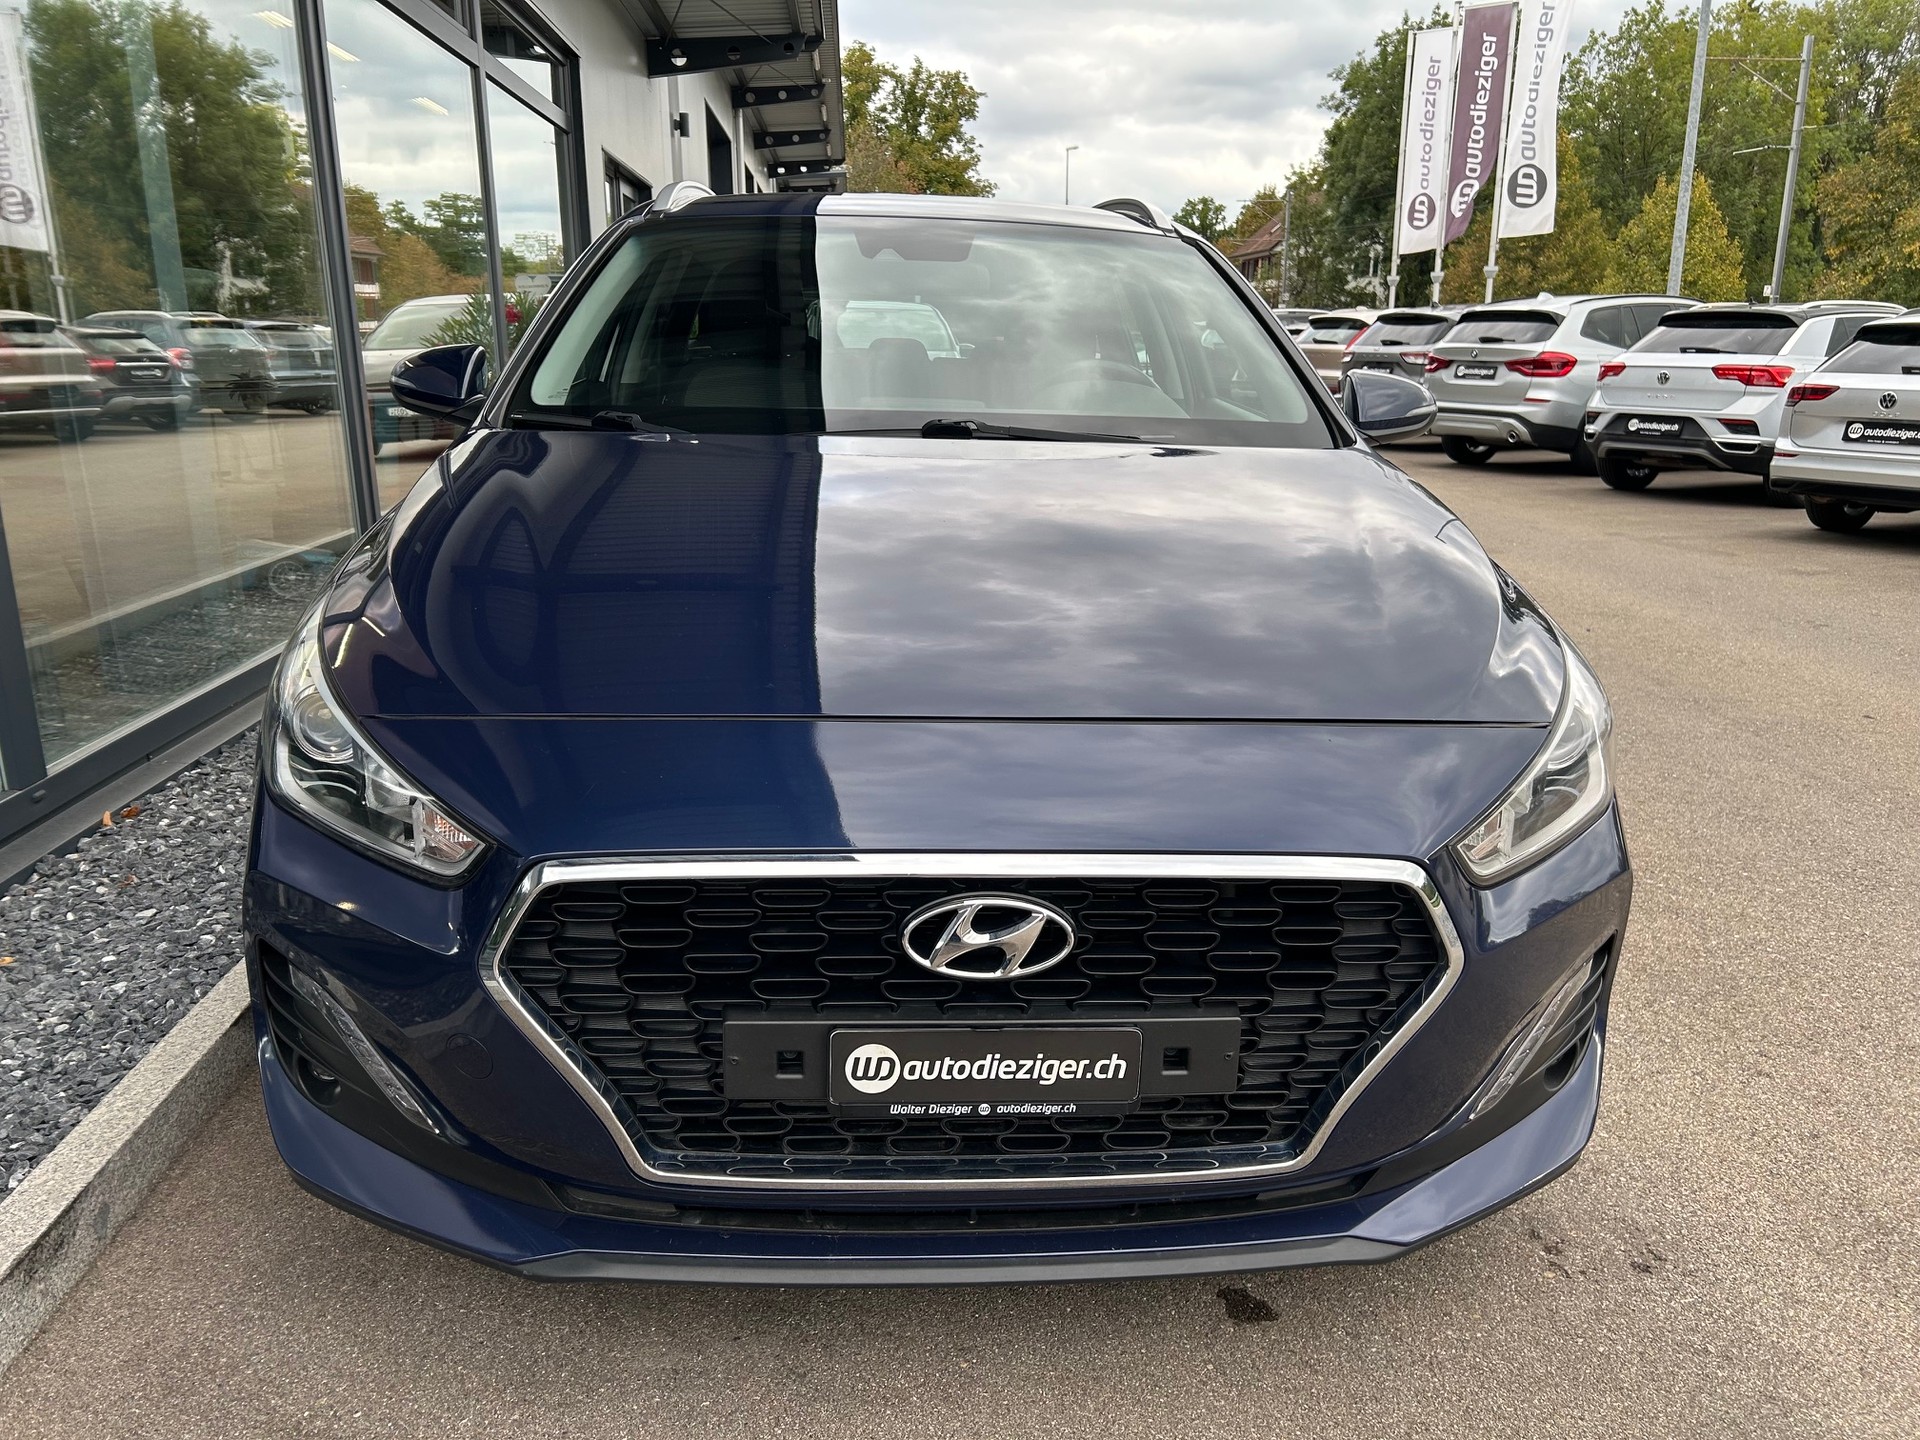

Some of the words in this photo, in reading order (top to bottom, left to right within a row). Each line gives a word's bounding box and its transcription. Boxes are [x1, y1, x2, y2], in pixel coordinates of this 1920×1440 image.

[1465, 32, 1498, 178] autodieziger
[1521, 1, 1556, 161] autodieziger
[1419, 56, 1442, 190] autodieziger
[1864, 428, 1920, 440] autodieziger.c
[890, 1104, 926, 1114] Walter
[928, 1104, 973, 1115] Dieziger
[996, 1103, 1077, 1115] autodieziger.ch
[903, 1053, 1127, 1086] autodieziger.ch
